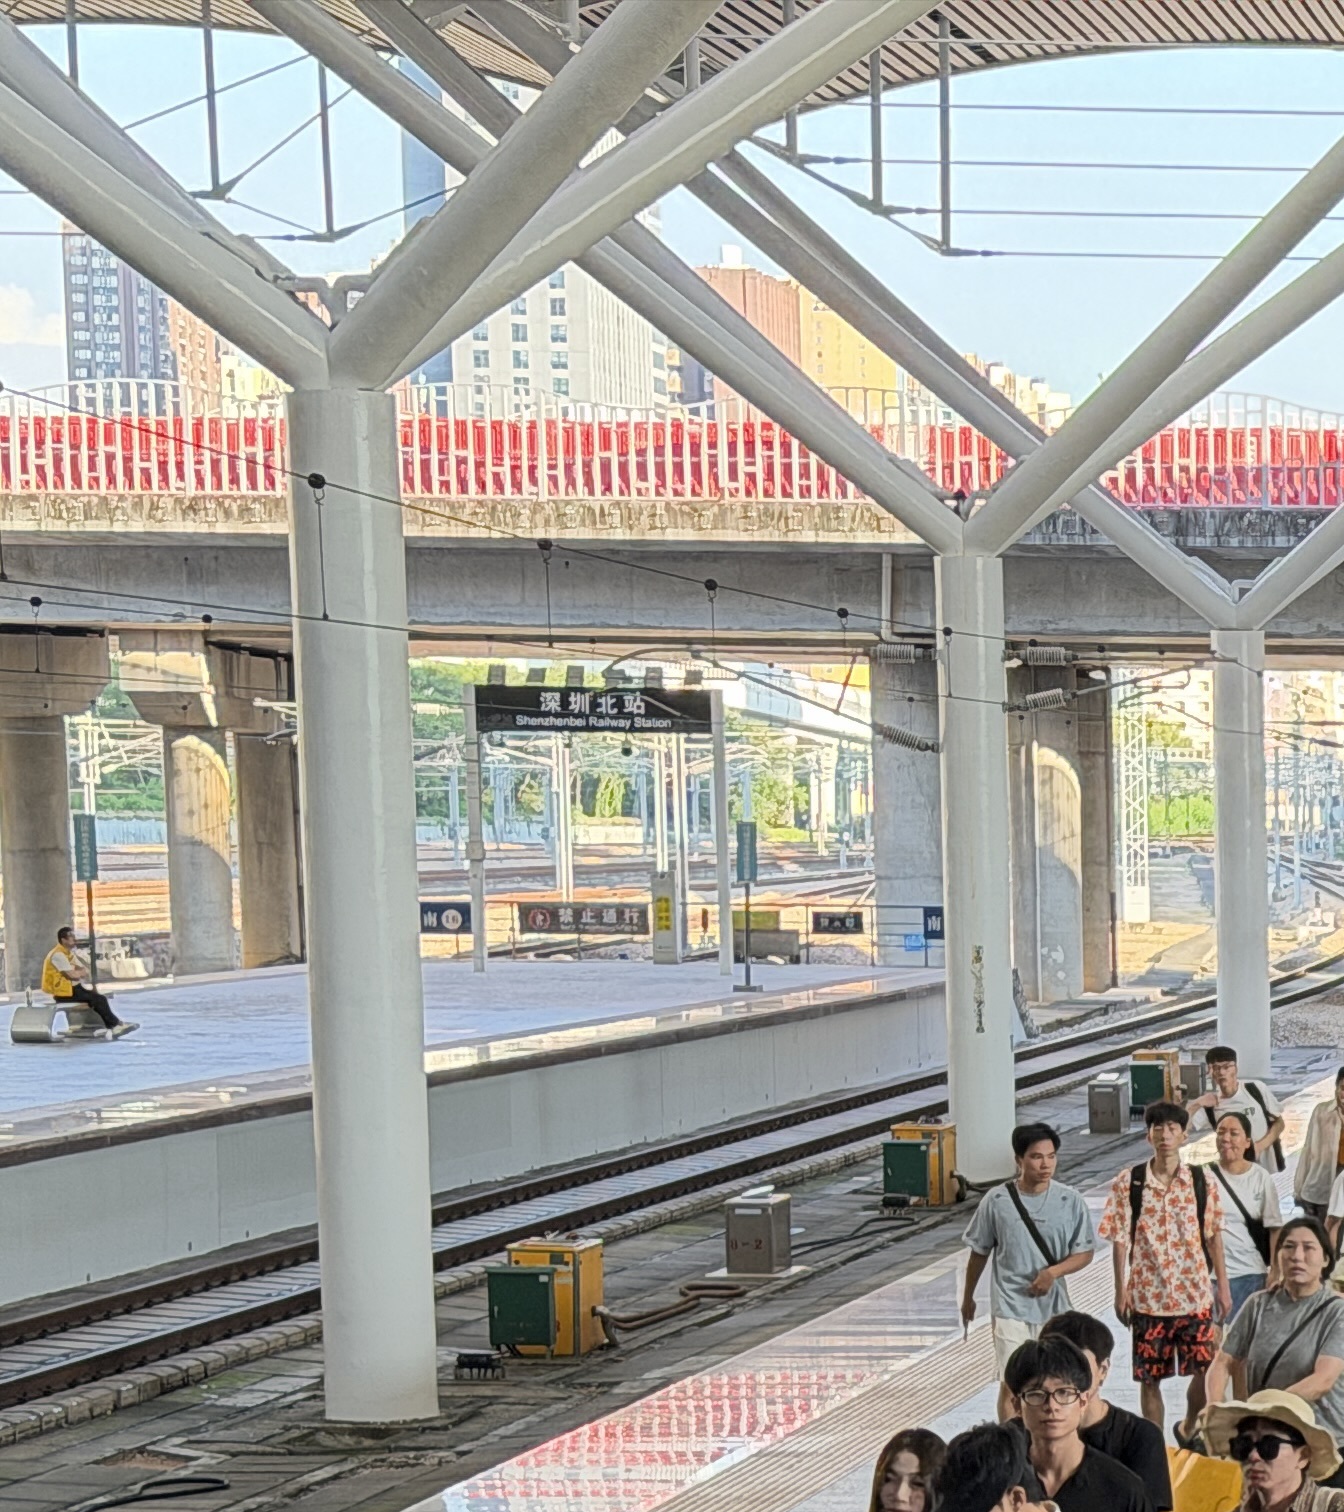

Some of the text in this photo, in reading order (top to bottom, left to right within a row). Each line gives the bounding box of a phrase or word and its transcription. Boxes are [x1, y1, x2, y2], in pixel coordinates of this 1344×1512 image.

[539, 691, 646, 714] 深圳北站
[516, 715, 672, 728] Shenzhenbei Railway Station
[557, 907, 640, 924] 禁止通行
